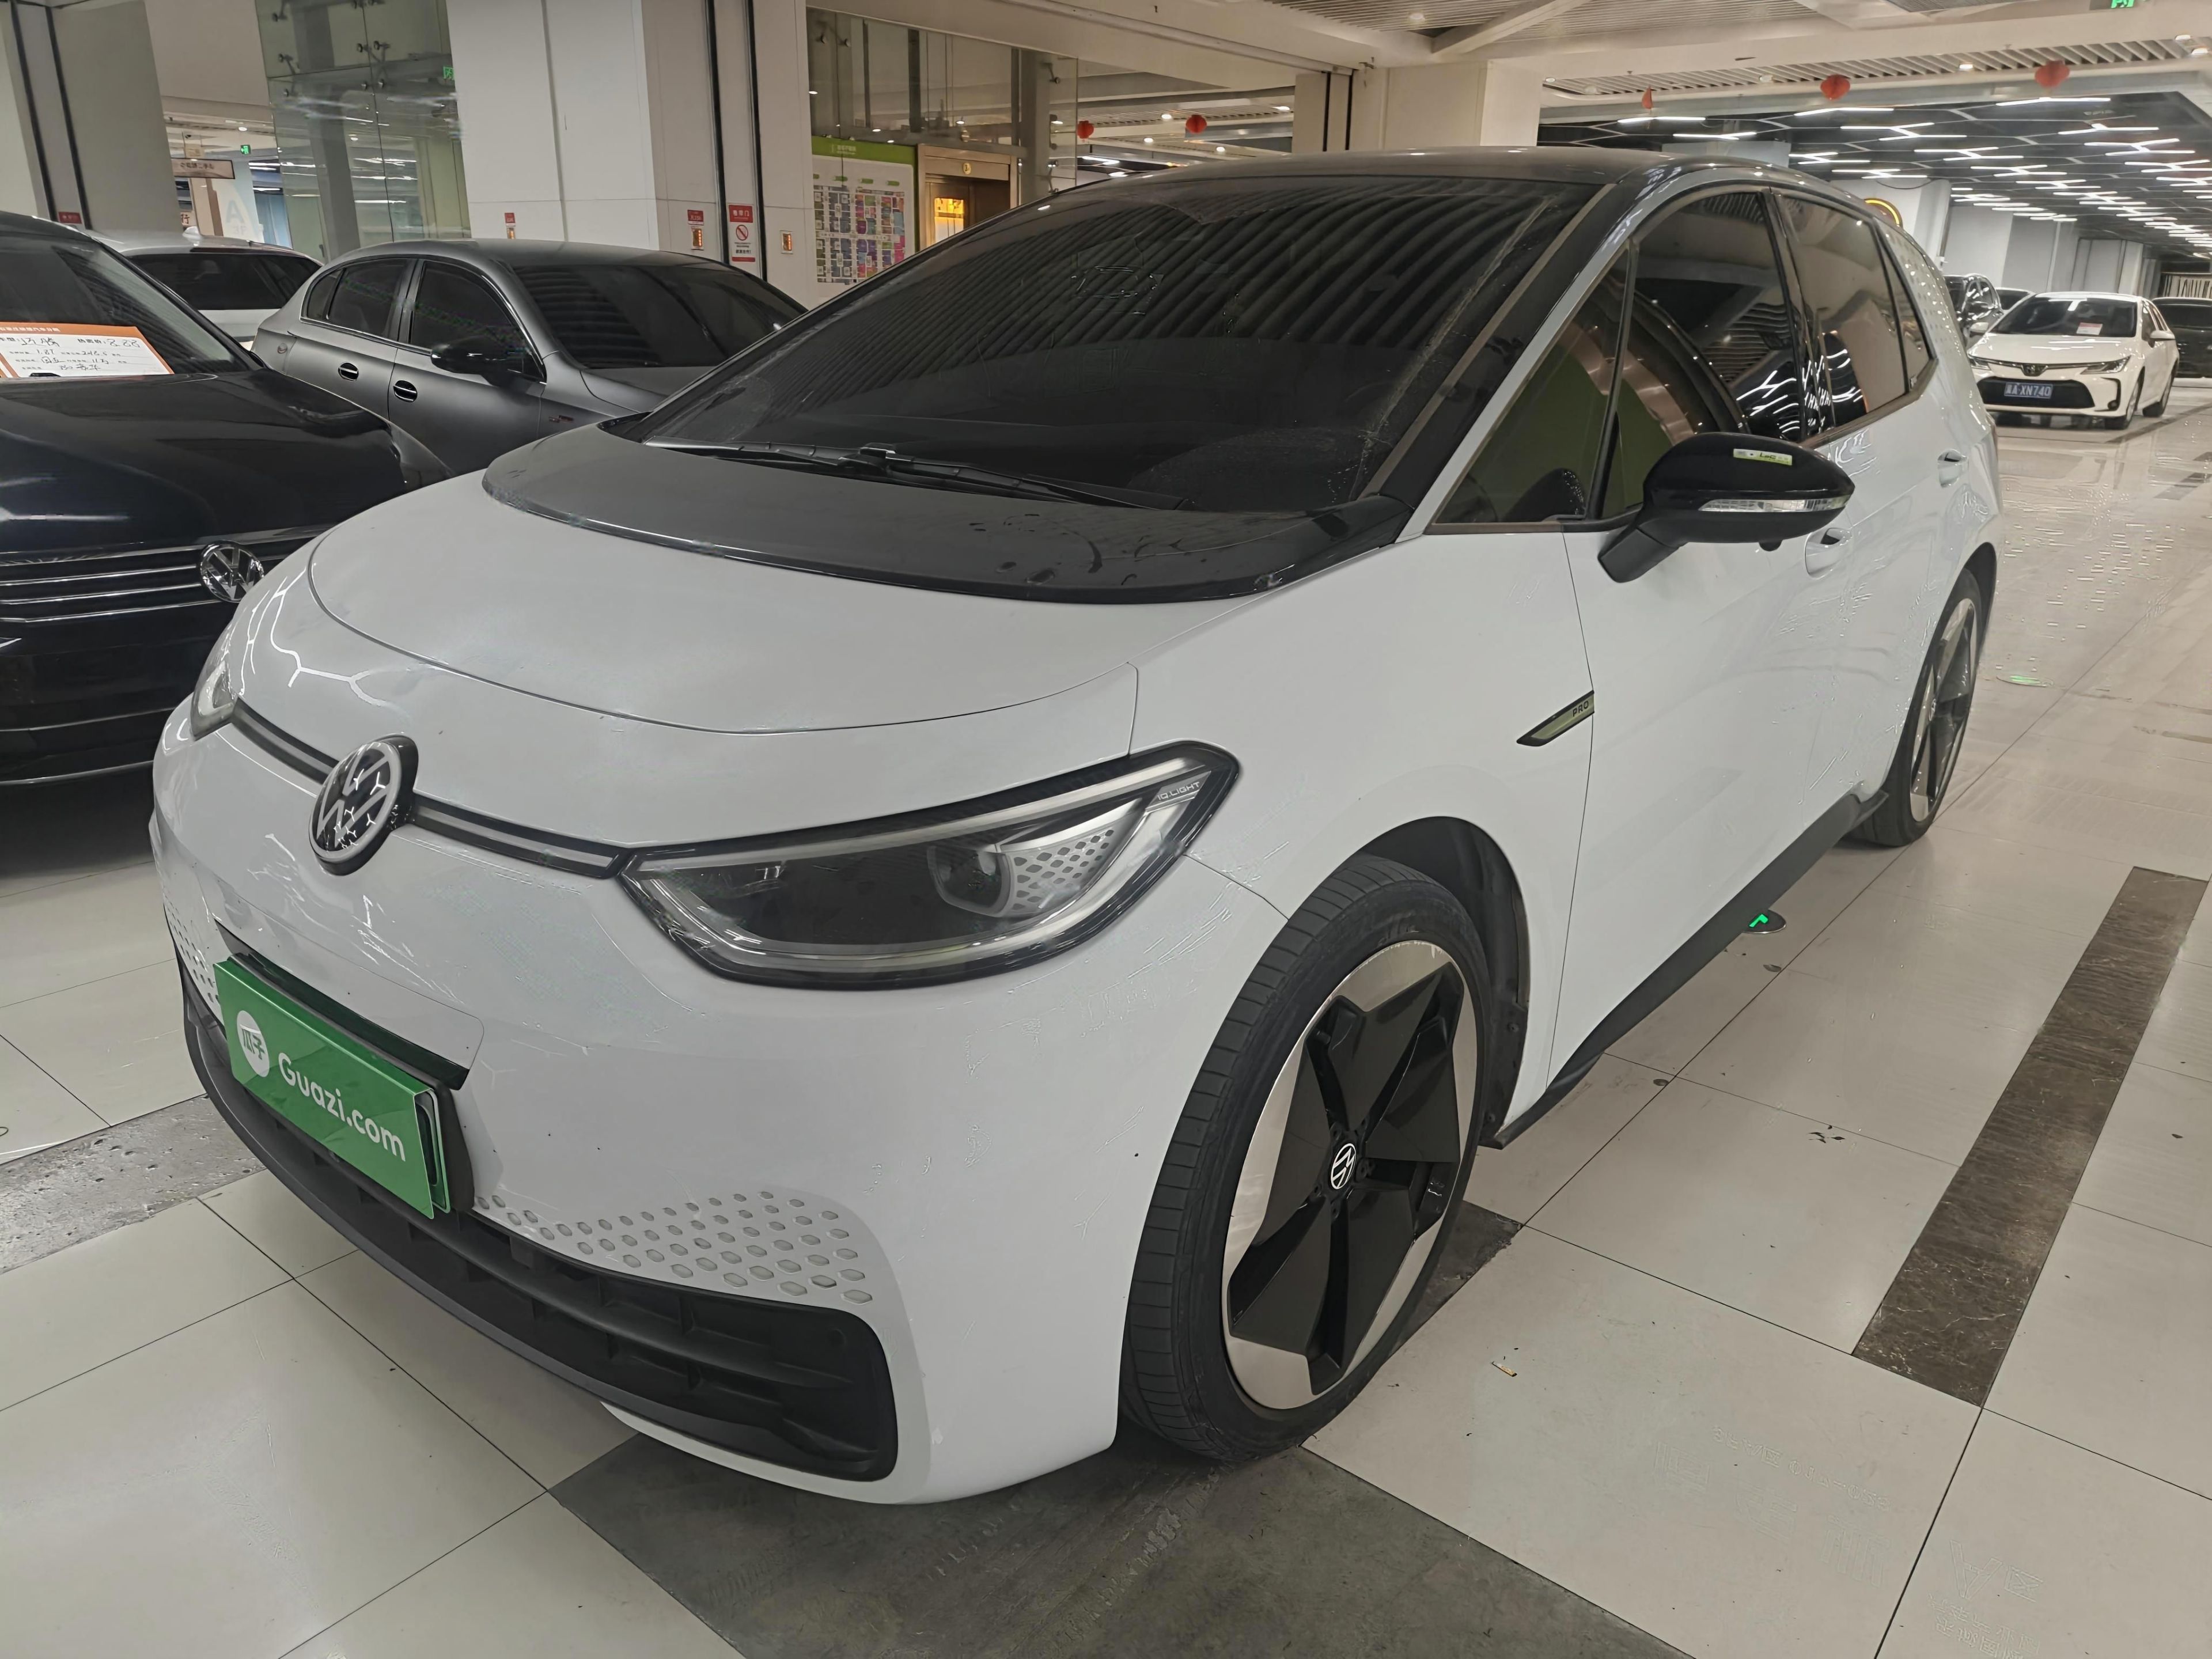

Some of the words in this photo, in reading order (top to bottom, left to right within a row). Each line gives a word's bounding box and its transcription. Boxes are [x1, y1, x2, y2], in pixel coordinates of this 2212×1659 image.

[1573, 700, 1589, 717] PRO
[1157, 781, 1200, 801] IQ.LIGHT
[278, 1052, 406, 1162] Guazi.com
